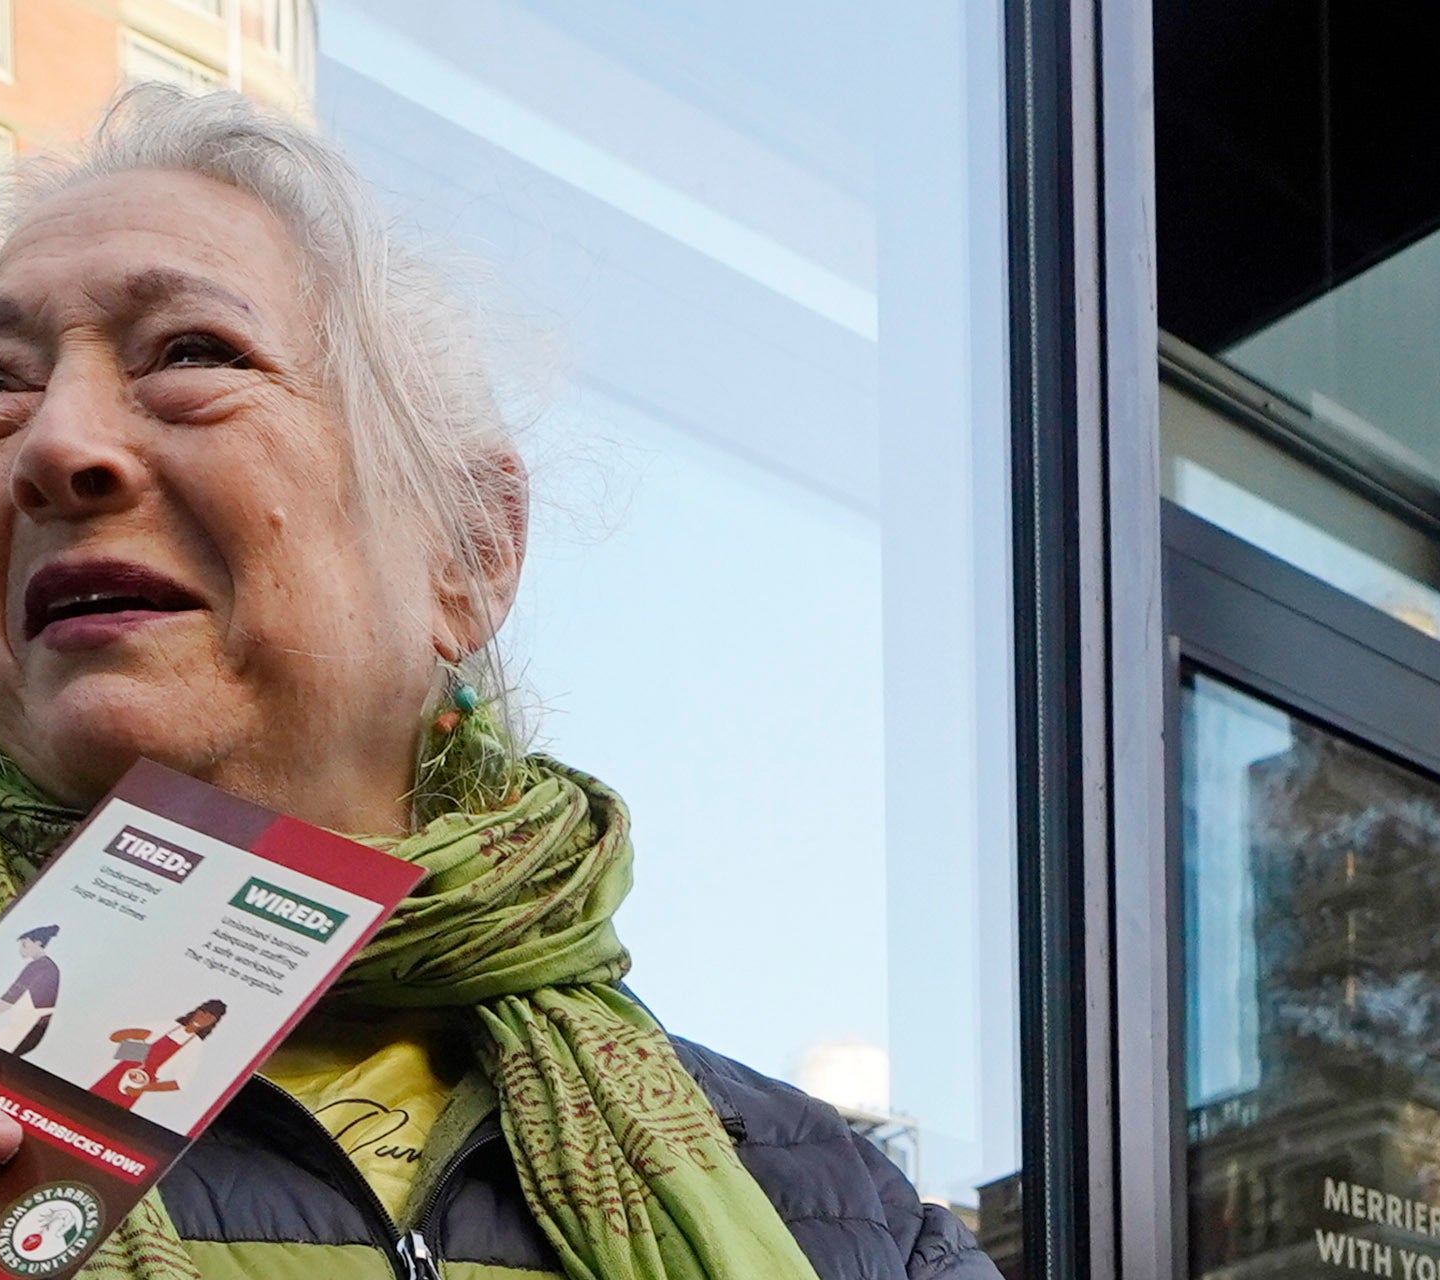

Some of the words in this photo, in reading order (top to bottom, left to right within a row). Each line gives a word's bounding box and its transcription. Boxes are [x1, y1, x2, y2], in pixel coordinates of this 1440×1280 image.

[115, 831, 193, 876] TIRED:
[243, 884, 335, 935] WIRED:
[19, 1108, 104, 1157] STARBUCKS
[100, 1148, 147, 1177] NOW!
[33, 1187, 100, 1230] STARBUCKS
[27, 1236, 89, 1275] UNITED
[1314, 1228, 1393, 1279] WITH
